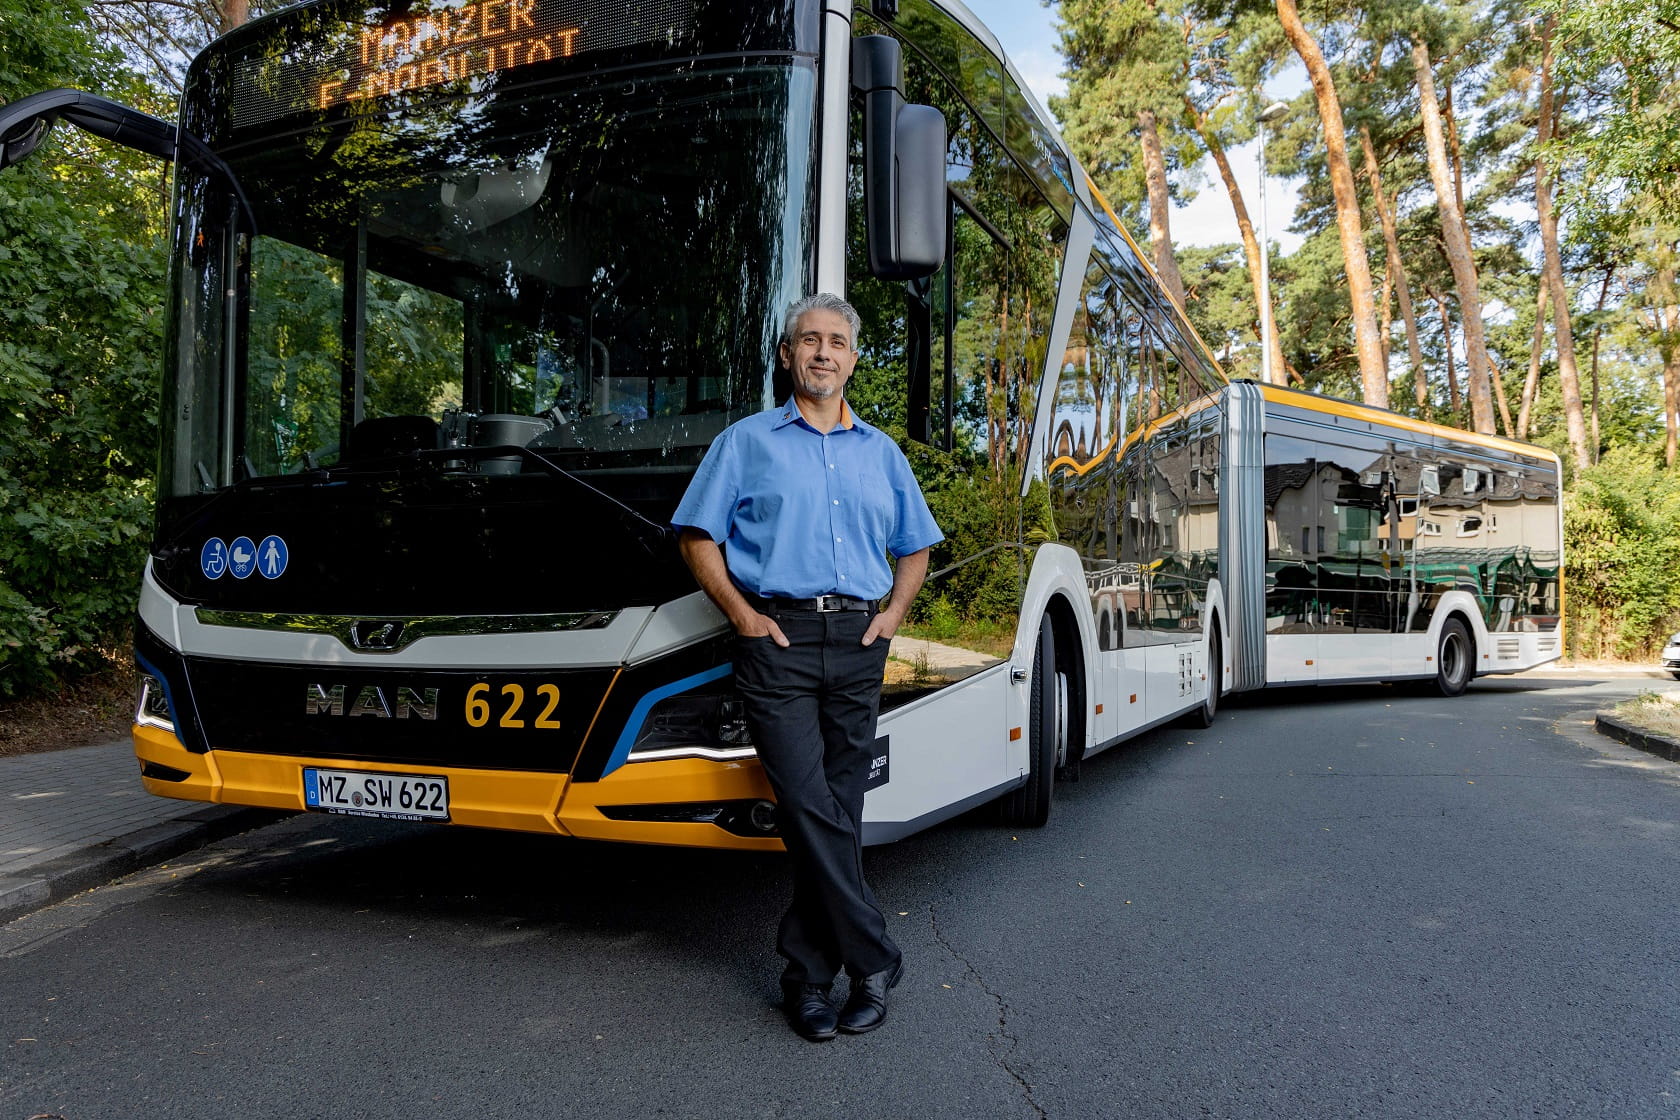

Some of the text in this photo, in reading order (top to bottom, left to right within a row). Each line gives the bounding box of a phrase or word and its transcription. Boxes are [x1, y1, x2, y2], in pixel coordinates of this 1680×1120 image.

[361, 0, 536, 65] MAINZER
[306, 683, 439, 720] MAN
[465, 682, 561, 729] 622
[310, 791, 316, 799] D
[319, 775, 443, 812] MZ SW 622
